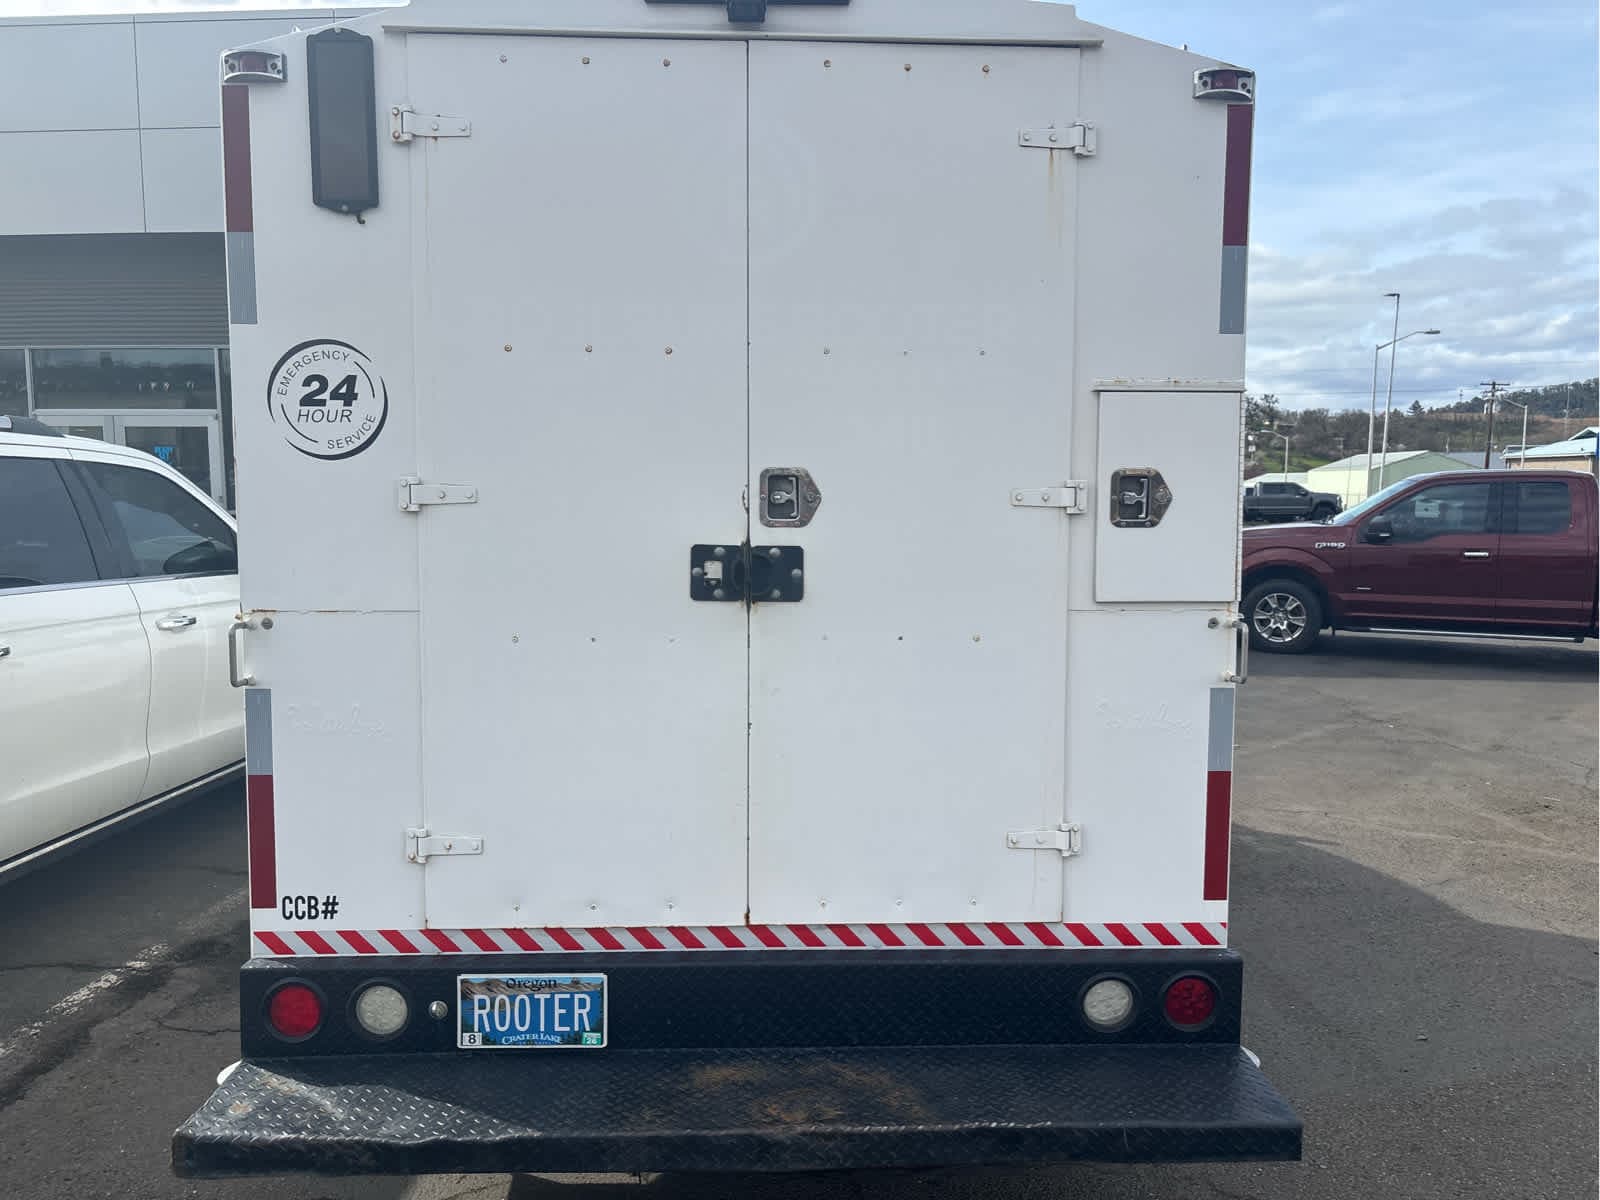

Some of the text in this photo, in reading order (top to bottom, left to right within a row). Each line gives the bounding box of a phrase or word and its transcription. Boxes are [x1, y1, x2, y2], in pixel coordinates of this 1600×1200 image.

[278, 350, 350, 396] EMERGENCY
[300, 374, 358, 407] 24
[298, 409, 353, 423] HOUR
[327, 414, 376, 449] SERVICE
[282, 895, 339, 920] CCB#
[505, 978, 558, 991] Oregon
[473, 993, 591, 1032] ROOTER
[468, 1033, 477, 1044] 8
